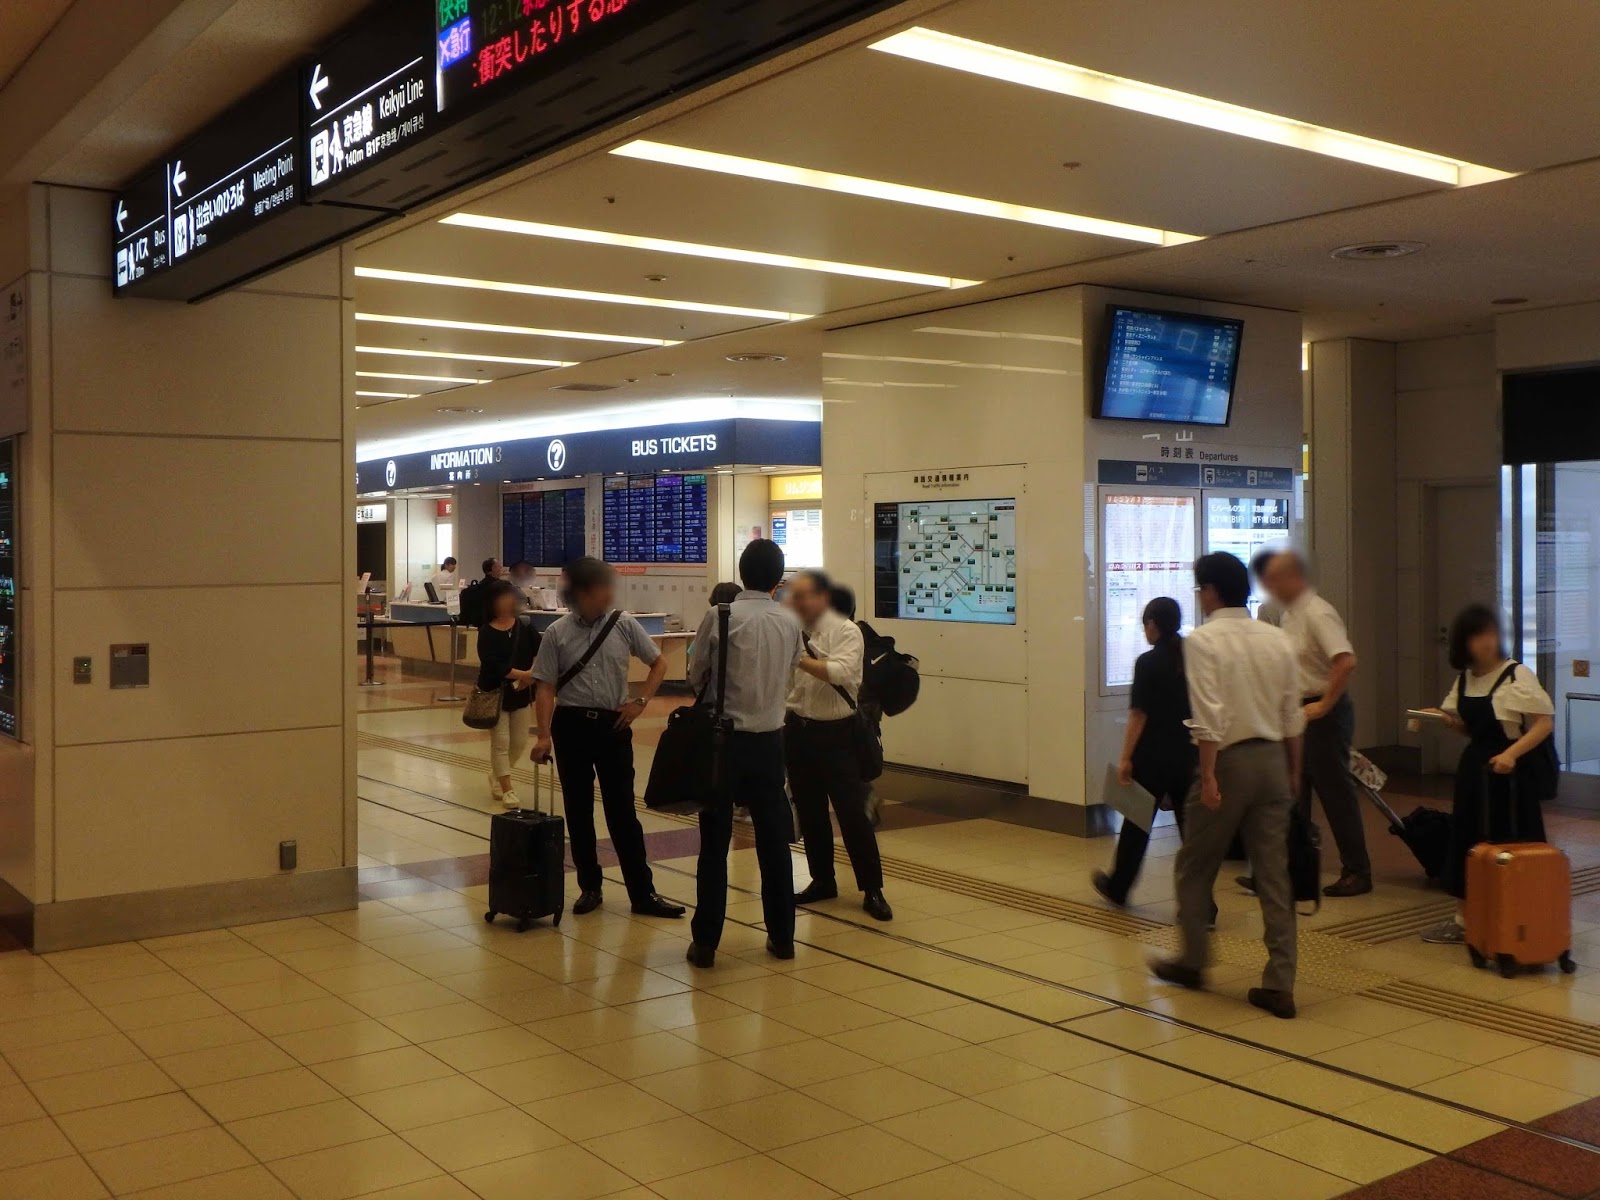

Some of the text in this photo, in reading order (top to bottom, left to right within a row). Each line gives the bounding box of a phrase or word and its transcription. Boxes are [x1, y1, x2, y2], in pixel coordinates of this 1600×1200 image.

[343, 78, 424, 147] 京急線 Keikyū Line
[345, 149, 364, 168] 140m
[366, 136, 381, 157] B1F
[195, 153, 294, 230] 出会いのひろば Meeting Point
[135, 230, 166, 262] バス Bus
[430, 446, 502, 470] INFORMATION 3
[631, 434, 717, 457] BUS TICKETS
[1160, 446, 1239, 462] 時刻表 Departures
